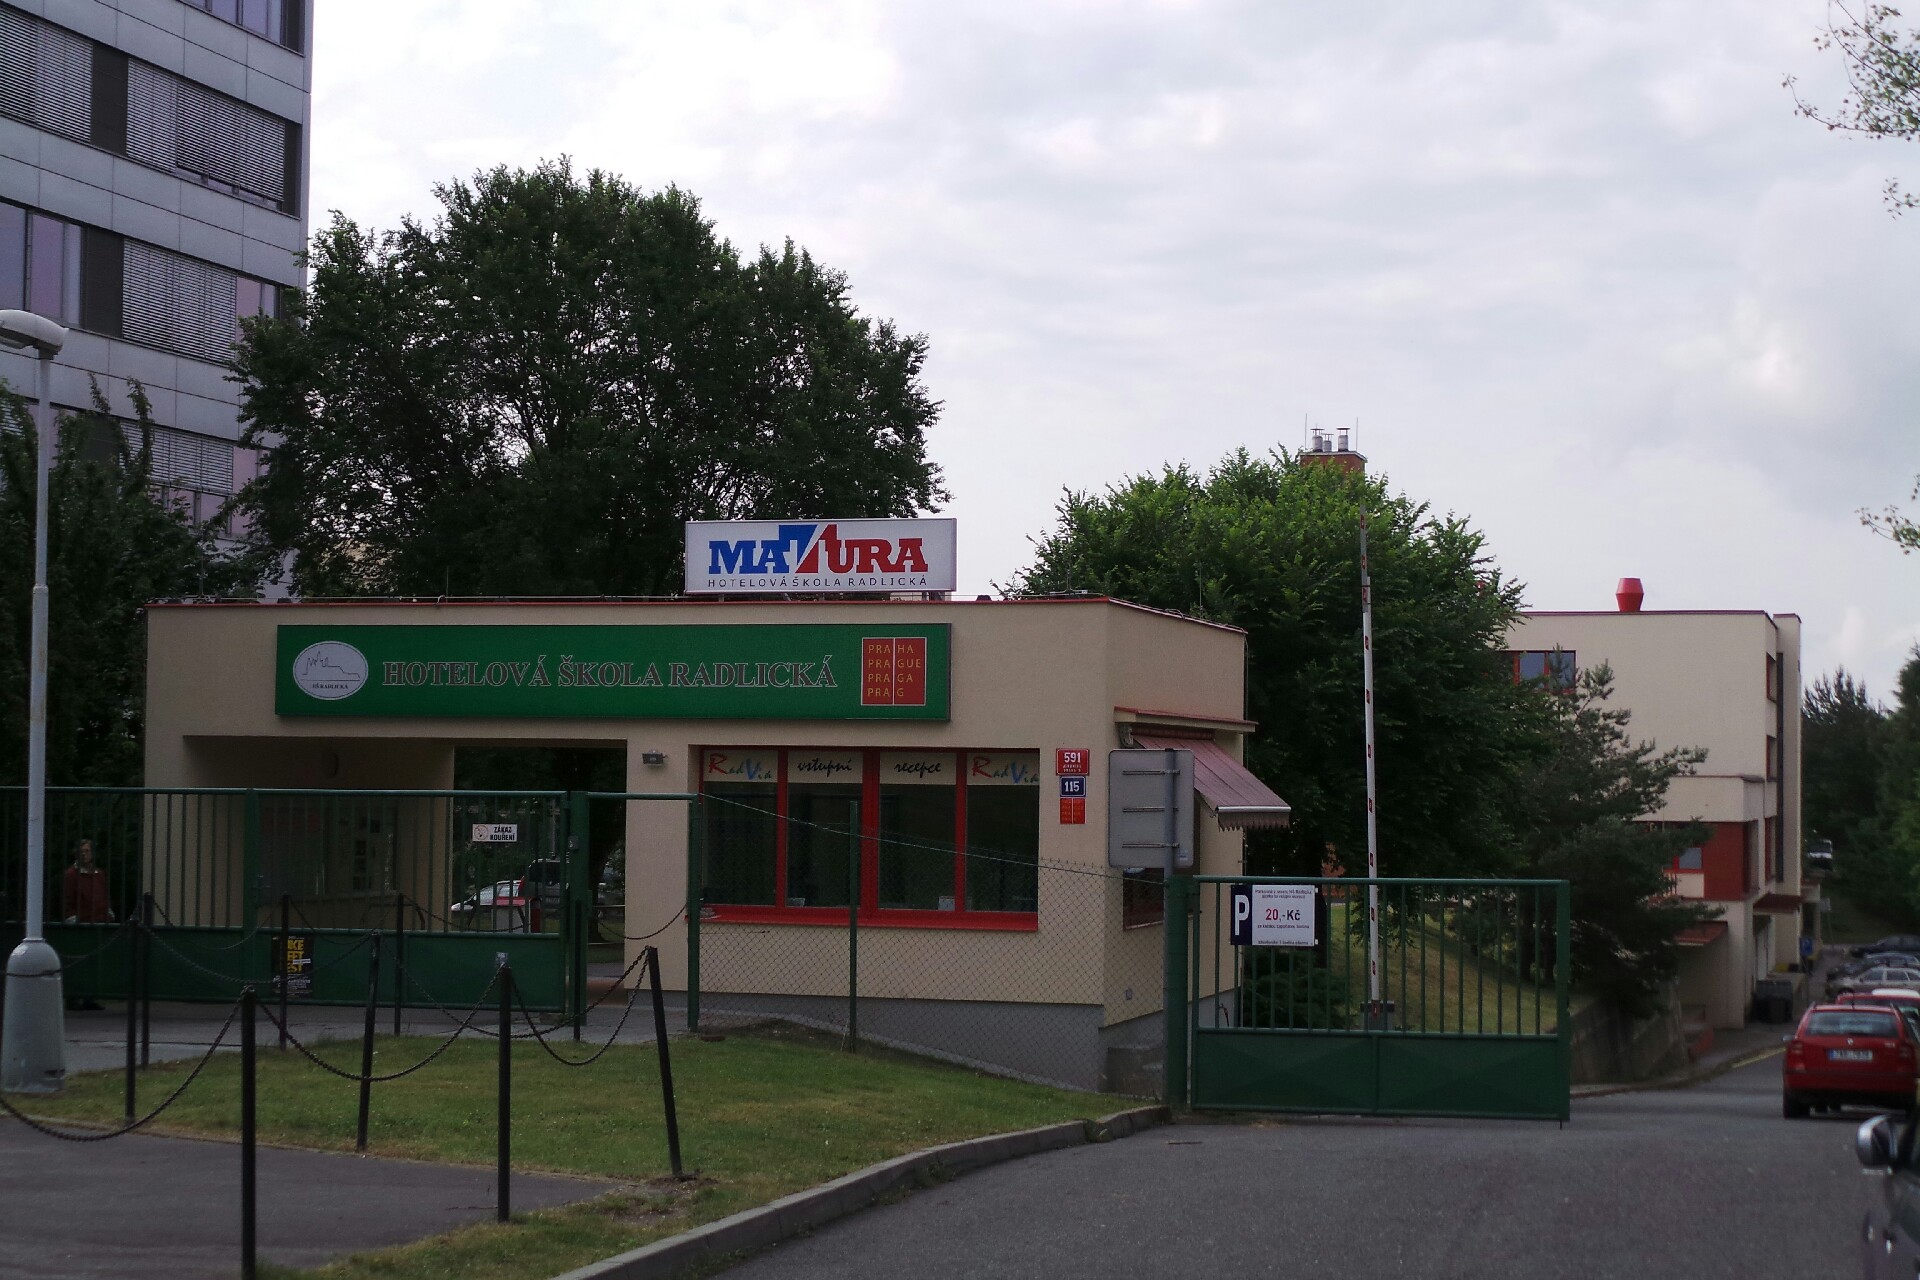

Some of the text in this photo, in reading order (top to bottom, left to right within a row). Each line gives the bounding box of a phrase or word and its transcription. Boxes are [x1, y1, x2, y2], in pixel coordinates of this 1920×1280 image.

[708, 574, 927, 588] HOTELOVÁ ŠKOLA RADLICKÁ
[382, 655, 838, 687] HOTELOVÁ ŠKOLA RADLICKÁ
[1064, 752, 1081, 763] 591
[797, 757, 853, 778] vstupní
[893, 761, 942, 779] recepce
[1064, 781, 1080, 792] 115
[493, 825, 512, 833] ZÁKAZ
[489, 833, 515, 841] KOUŘENÍ
[1234, 894, 1250, 936] P
